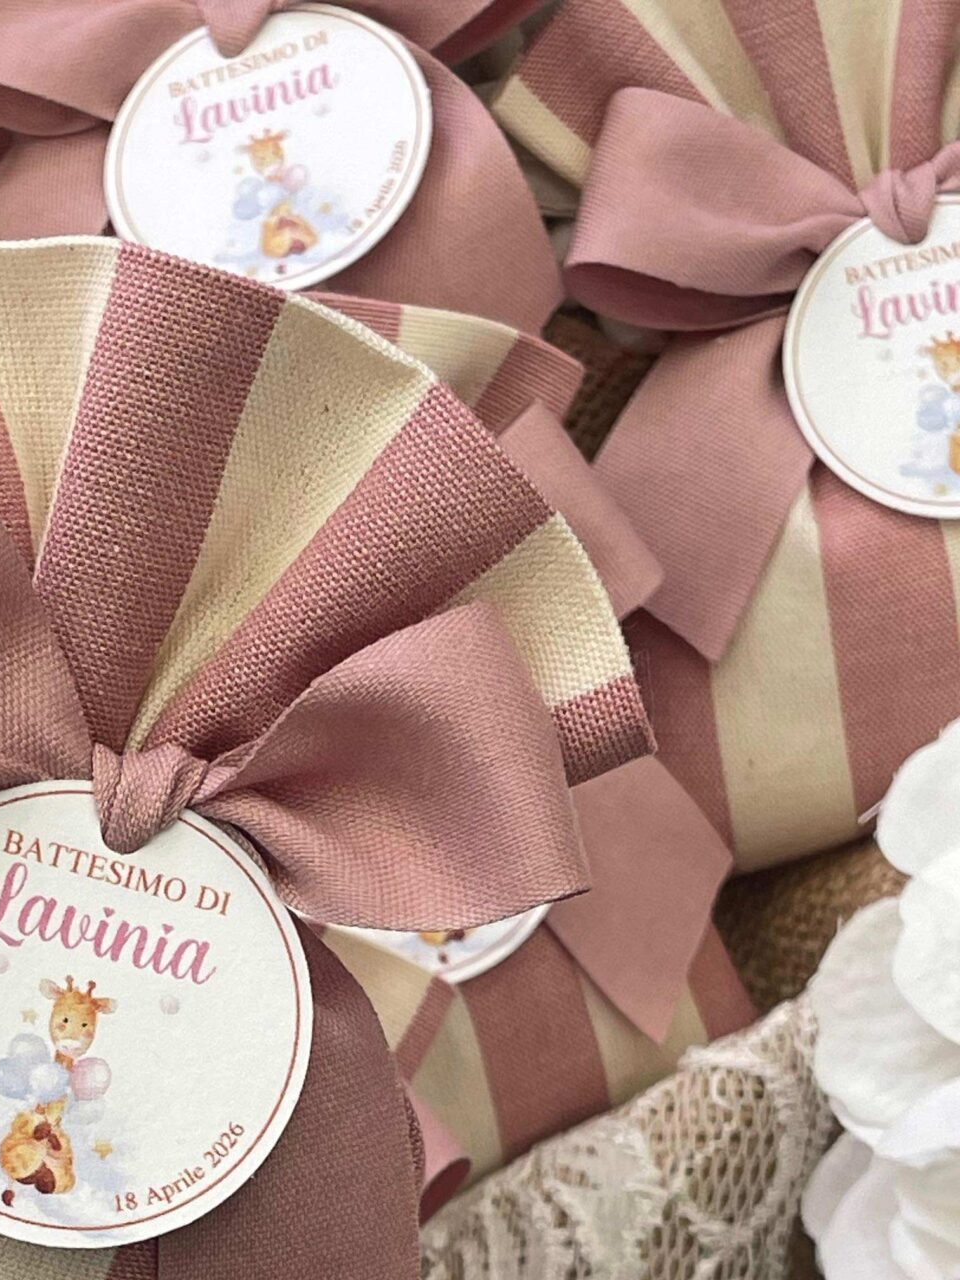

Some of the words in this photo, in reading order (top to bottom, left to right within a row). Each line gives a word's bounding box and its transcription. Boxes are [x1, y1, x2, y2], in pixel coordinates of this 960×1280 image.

[167, 42, 299, 98] BATTESIMO
[302, 30, 329, 52] DI
[174, 63, 339, 145] Lavinia
[844, 242, 960, 285] BATTESIM
[3, 829, 187, 902] BATTESIMO
[195, 886, 232, 916] DI
[114, 1193, 138, 1213] 18
[146, 1167, 206, 1204] Aprile
[204, 1121, 246, 1169] 2026
